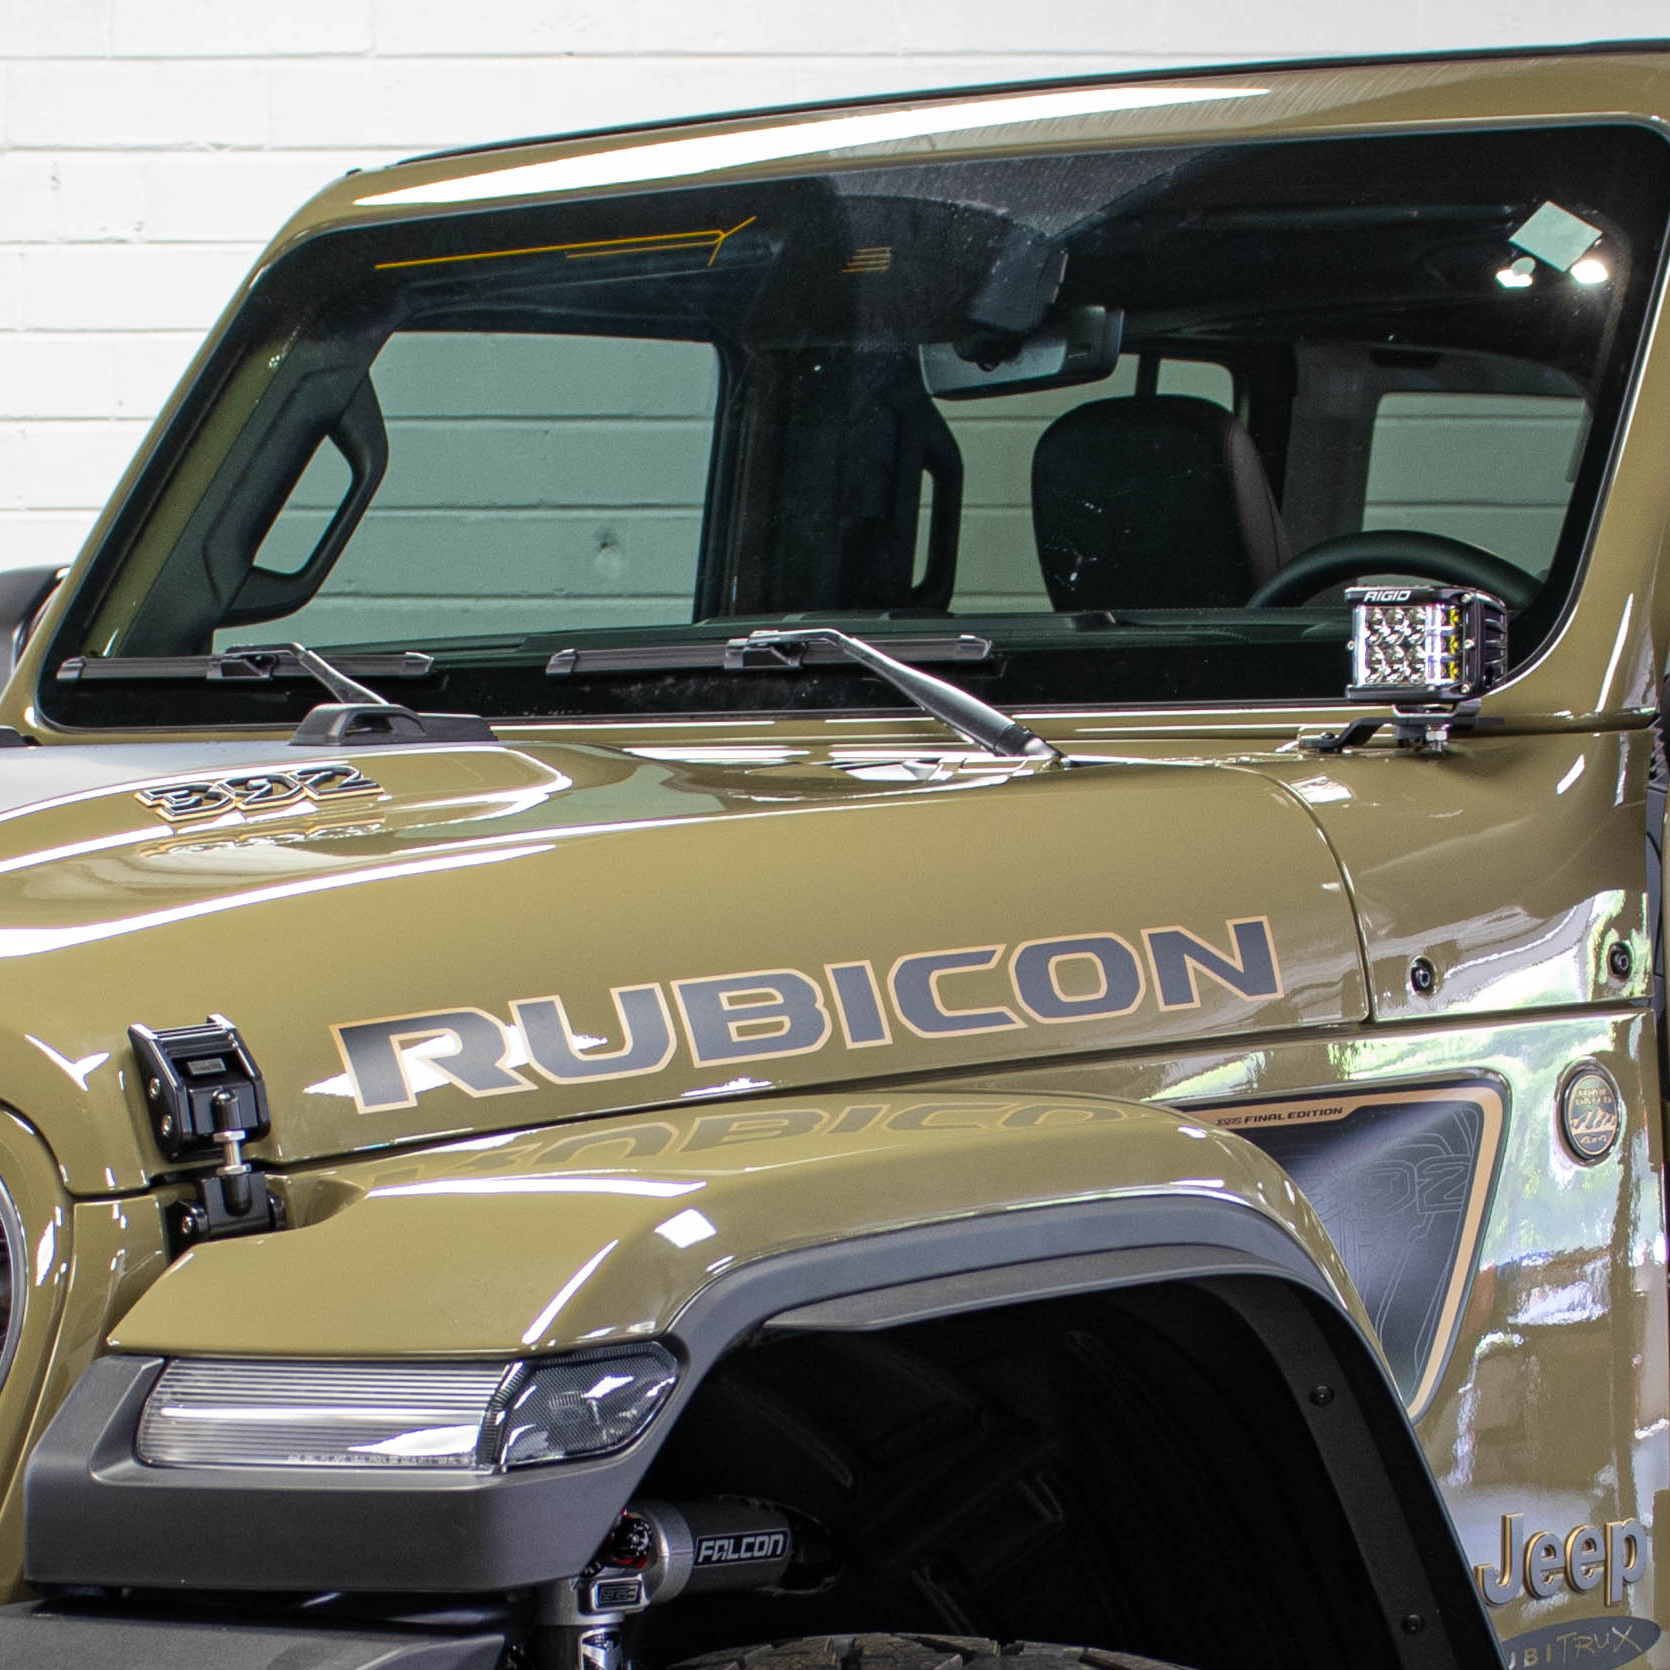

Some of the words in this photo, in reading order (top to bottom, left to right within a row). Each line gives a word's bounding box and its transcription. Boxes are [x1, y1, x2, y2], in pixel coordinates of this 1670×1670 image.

[1364, 589, 1412, 602] RIGID
[135, 764, 386, 823] 392
[330, 915, 1284, 1115] RUBICON
[1243, 1112, 1285, 1125] FINAL
[1287, 1106, 1344, 1120] EDITION
[698, 1533, 785, 1563] FALCON
[1476, 1512, 1649, 1607] Jeep
